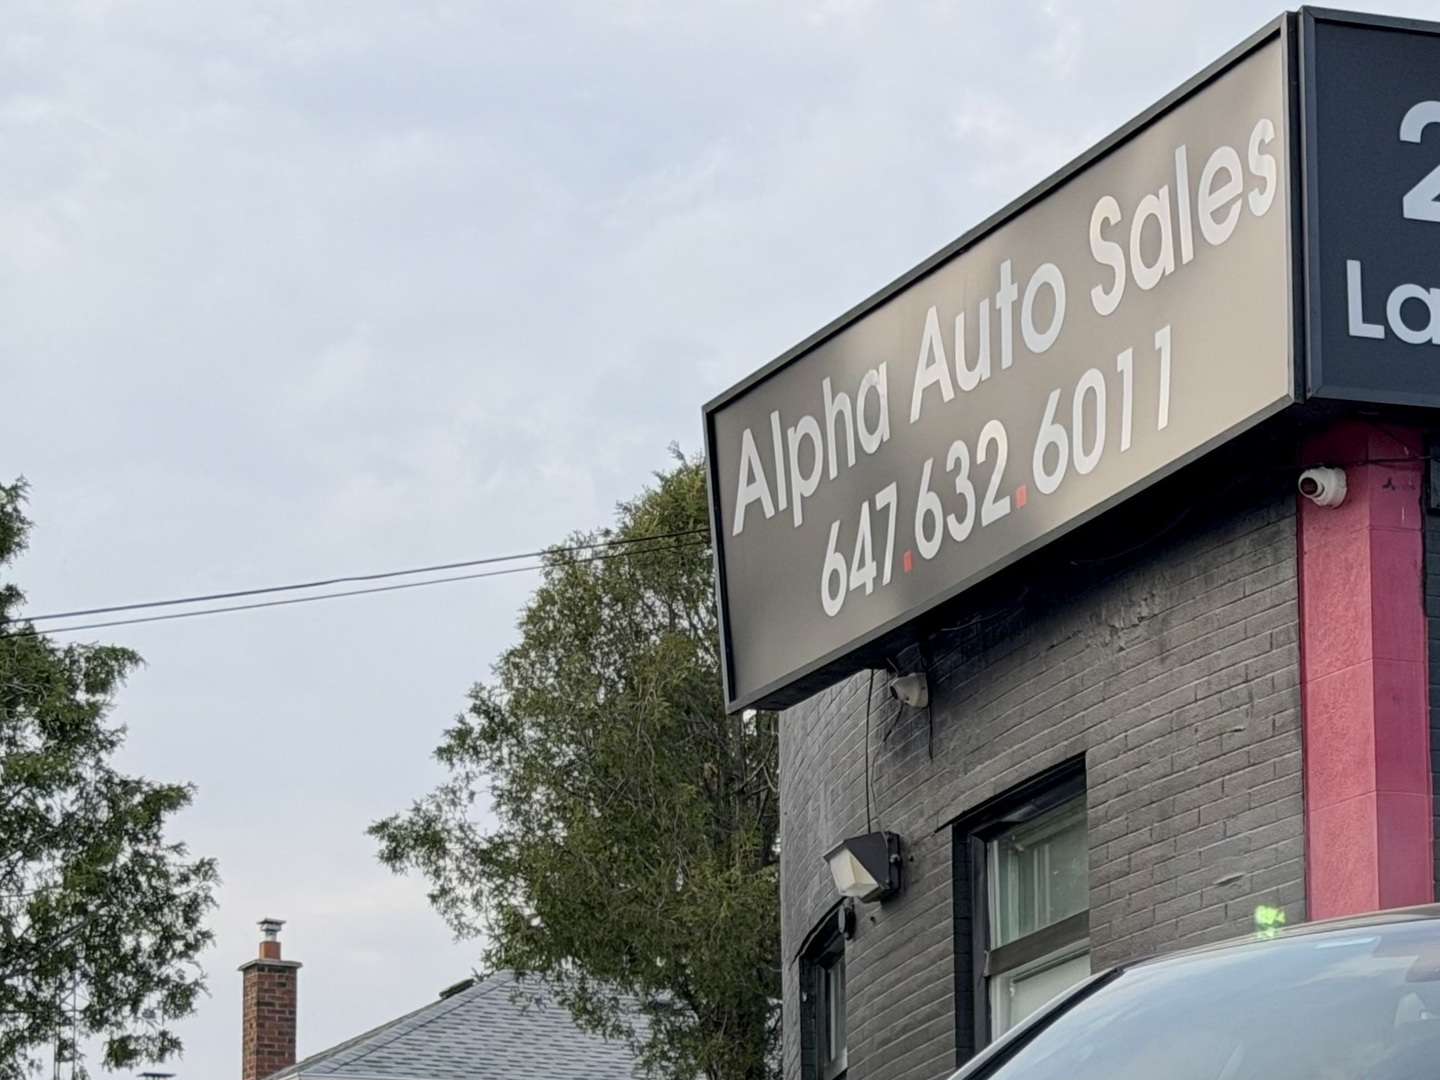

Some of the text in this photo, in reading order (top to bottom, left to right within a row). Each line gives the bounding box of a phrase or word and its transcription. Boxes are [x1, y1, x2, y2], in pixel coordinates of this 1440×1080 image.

[732, 118, 1277, 537] Alpha Auto Sales
[821, 324, 1171, 617] 647.632.6011
